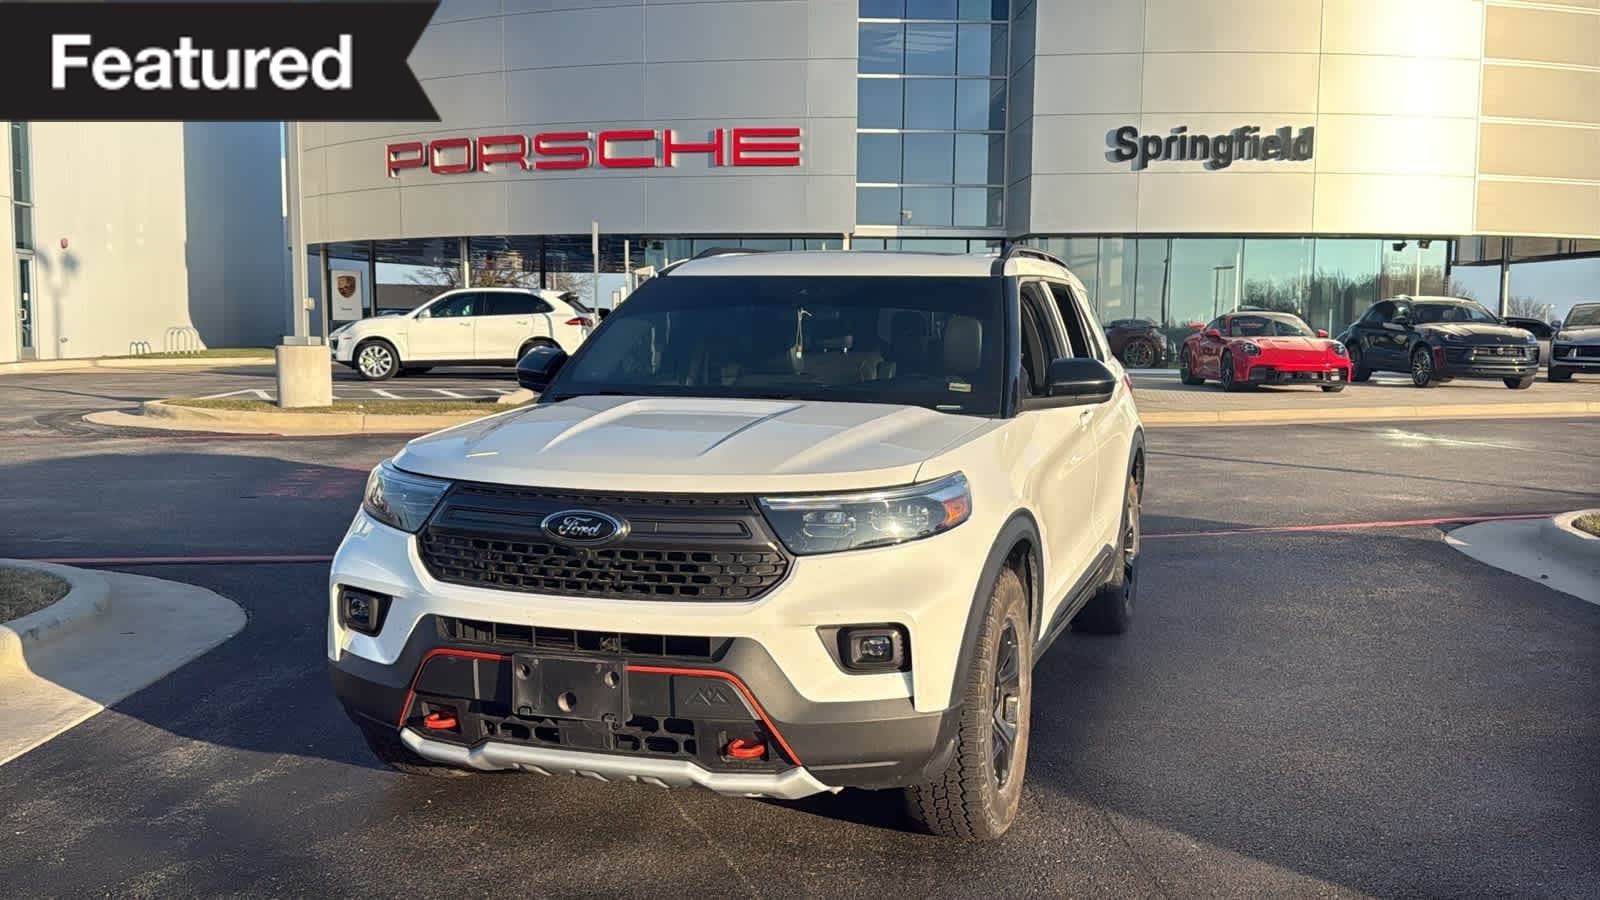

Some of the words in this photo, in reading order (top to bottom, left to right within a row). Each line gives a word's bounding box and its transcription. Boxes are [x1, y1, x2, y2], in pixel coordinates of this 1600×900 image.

[385, 127, 801, 178] PORSCHE
[1108, 125, 1315, 171] Springfield
[558, 515, 603, 537] Ford
